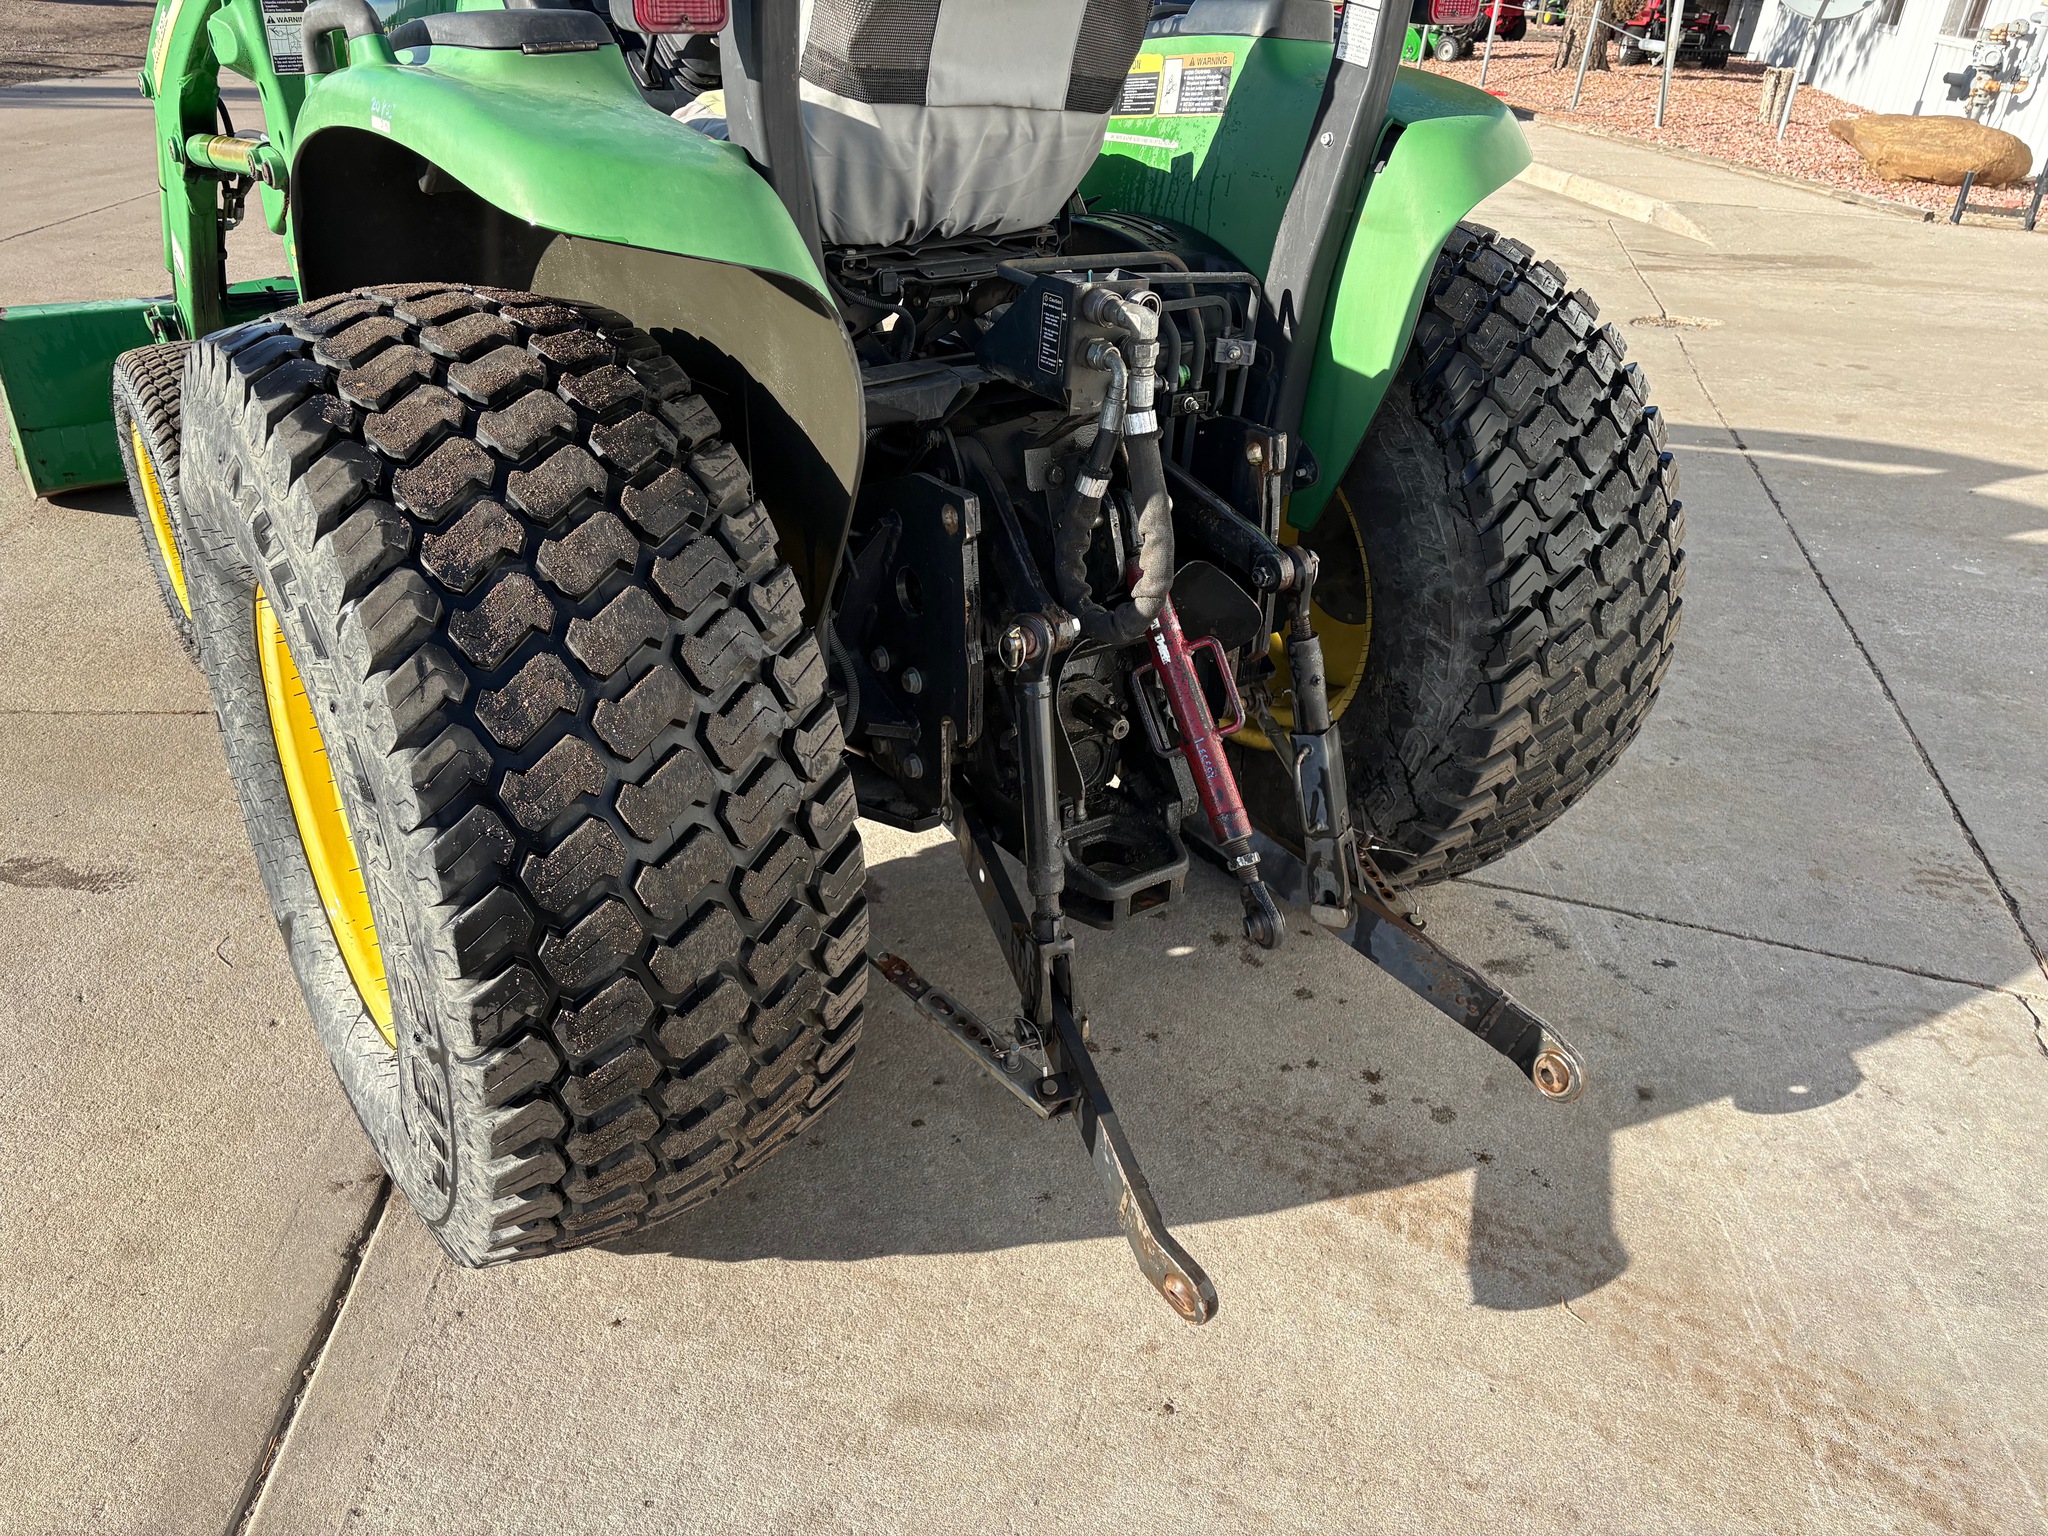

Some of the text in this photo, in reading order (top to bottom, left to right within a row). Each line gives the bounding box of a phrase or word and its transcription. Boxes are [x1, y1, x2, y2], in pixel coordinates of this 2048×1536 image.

[276, 16, 303, 24] WARNI
[1197, 56, 1228, 66] WARNING
[1048, 296, 1062, 305] Caution
